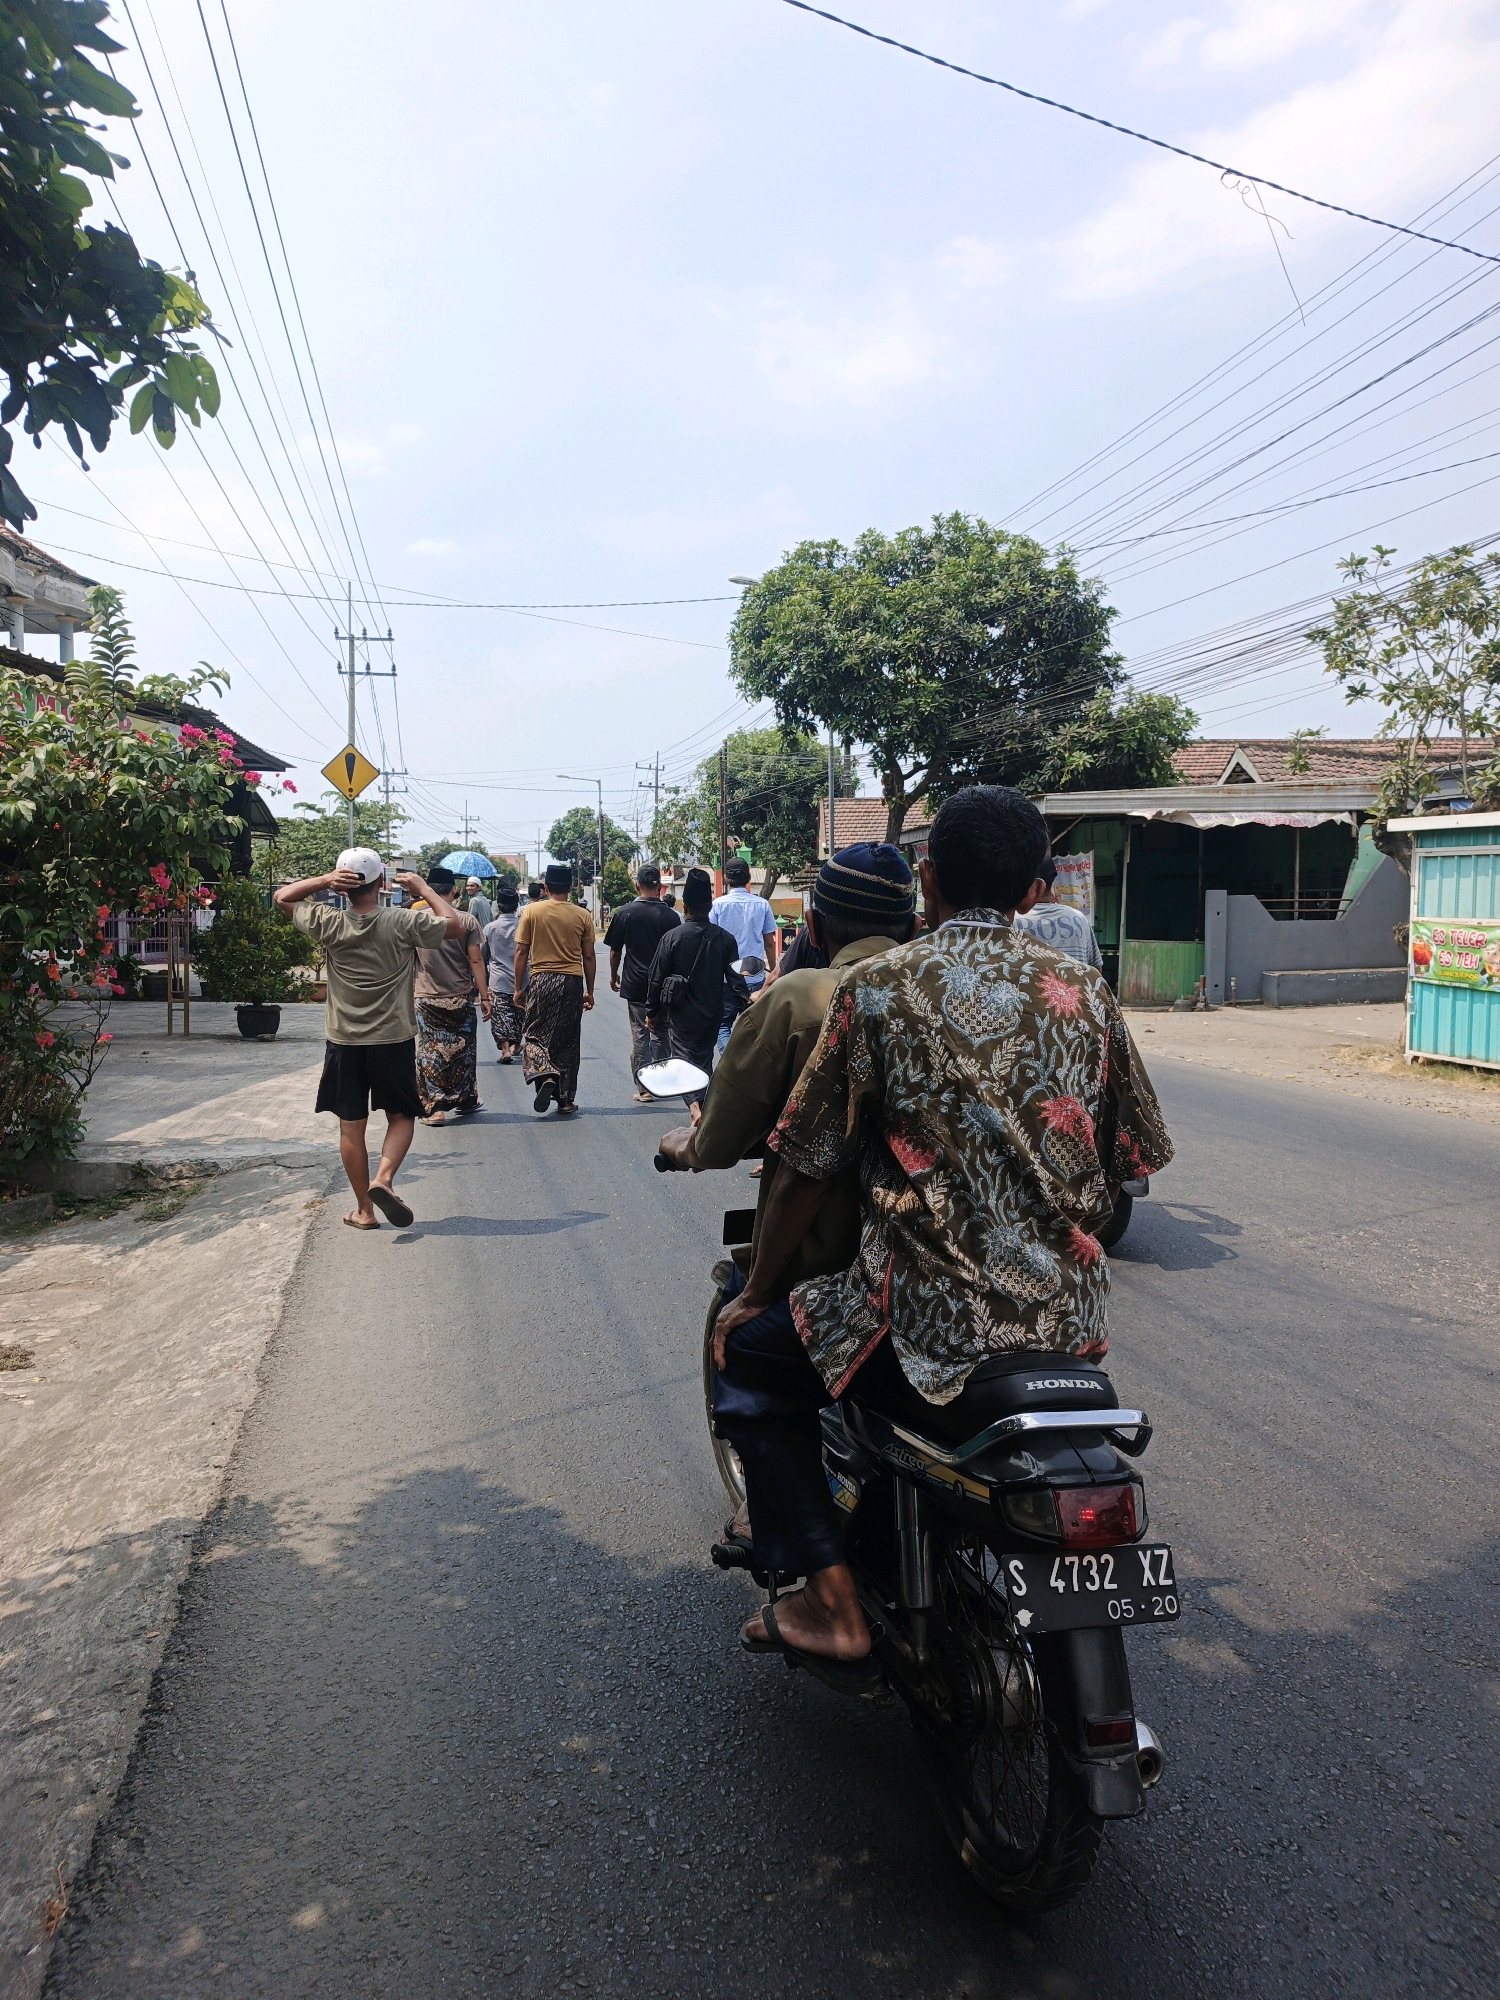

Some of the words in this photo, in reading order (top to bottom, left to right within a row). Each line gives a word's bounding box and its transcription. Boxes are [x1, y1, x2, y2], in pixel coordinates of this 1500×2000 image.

[1016, 915, 1083, 940] BOSS
[1432, 928, 1446, 945] ES
[1450, 929, 1487, 948] TELER
[1439, 950, 1453, 966] ES
[1456, 951, 1480, 969] TEH
[1025, 1379, 1104, 1391] HONDA
[880, 1442, 925, 1470] Astrea
[837, 1471, 857, 1496] HONDA
[1008, 1559, 1027, 1596] S
[1050, 1553, 1118, 1594] 4732
[1137, 1549, 1174, 1587] XZ
